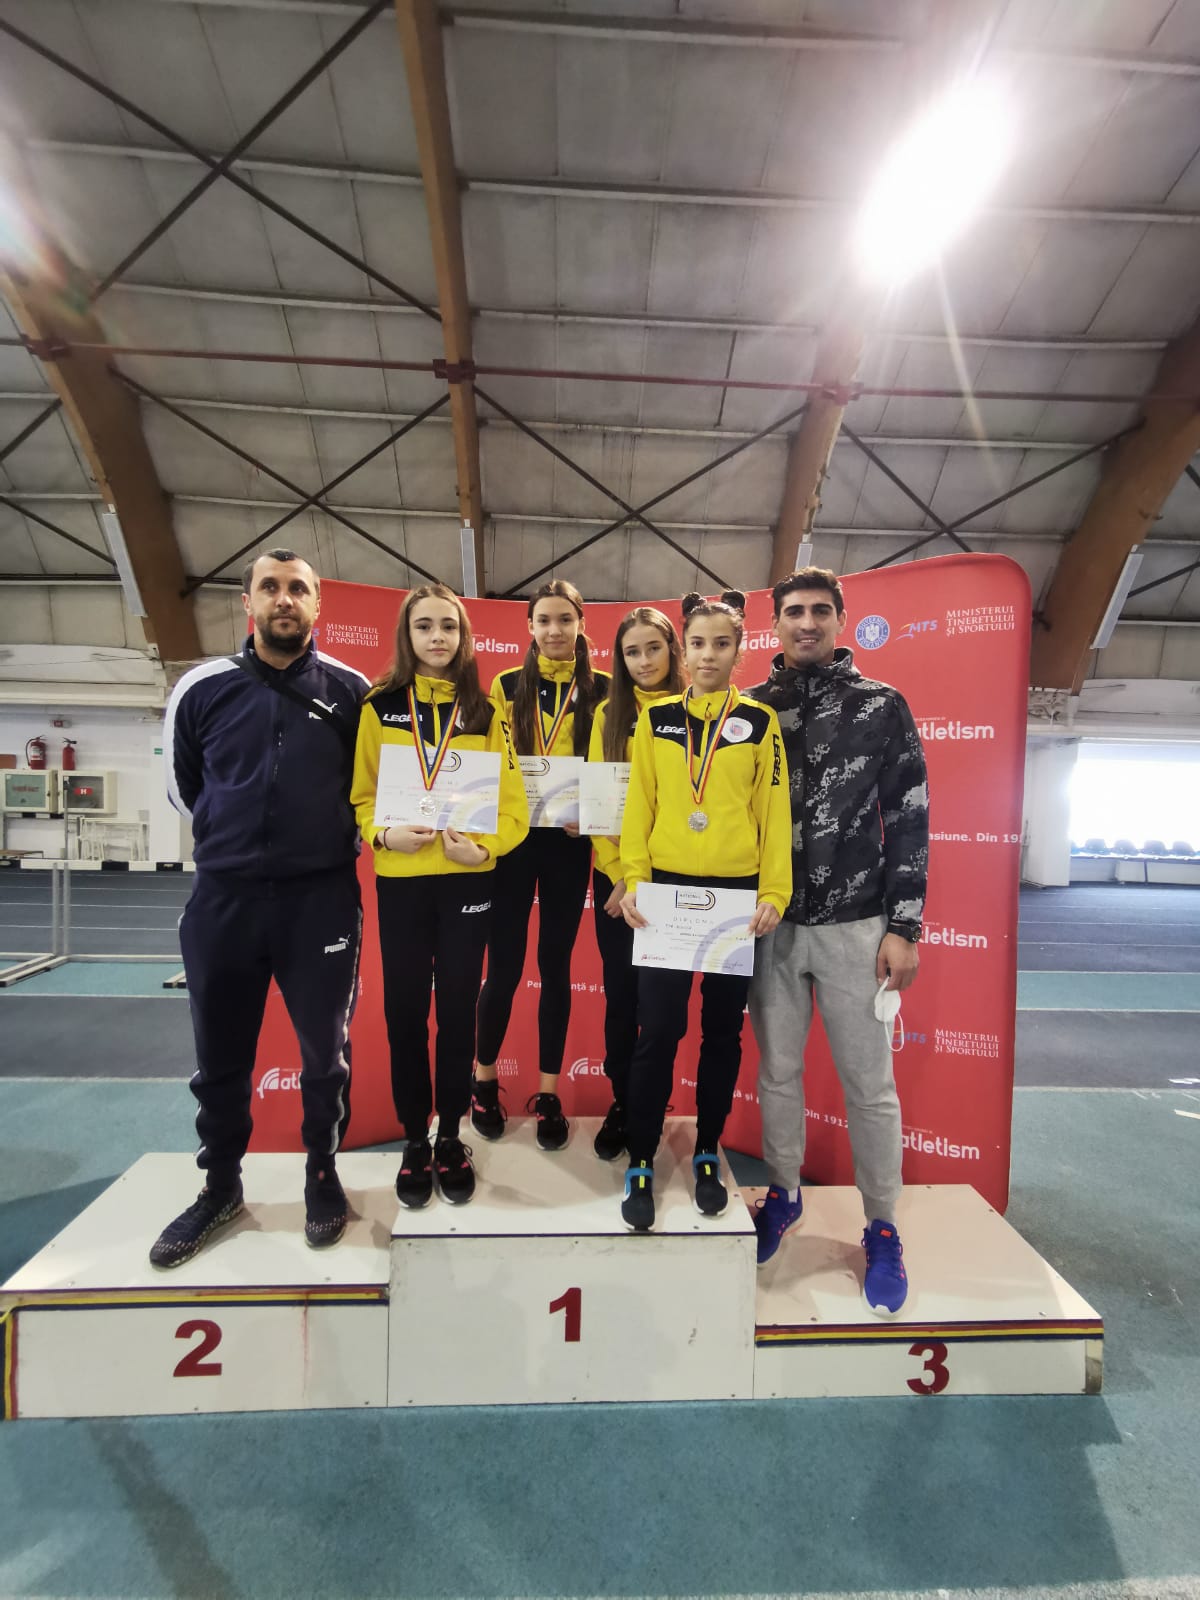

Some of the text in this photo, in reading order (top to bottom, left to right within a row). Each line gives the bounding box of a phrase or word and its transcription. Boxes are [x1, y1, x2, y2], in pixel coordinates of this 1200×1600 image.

[946, 606, 1013, 618] MINISTERUL
[326, 623, 380, 634] MINISTERUL
[958, 622, 1015, 634] SPORTULUI
[335, 637, 379, 647] SPORTULUI
[771, 733, 781, 786] LEGEA
[976, 832, 998, 842] Din
[935, 1028, 999, 1043] MINISTERUL
[946, 1045, 999, 1058] SPORTULUI
[549, 1287, 581, 1342] 1
[173, 1319, 223, 1377] 2
[906, 1342, 950, 1394] 3
